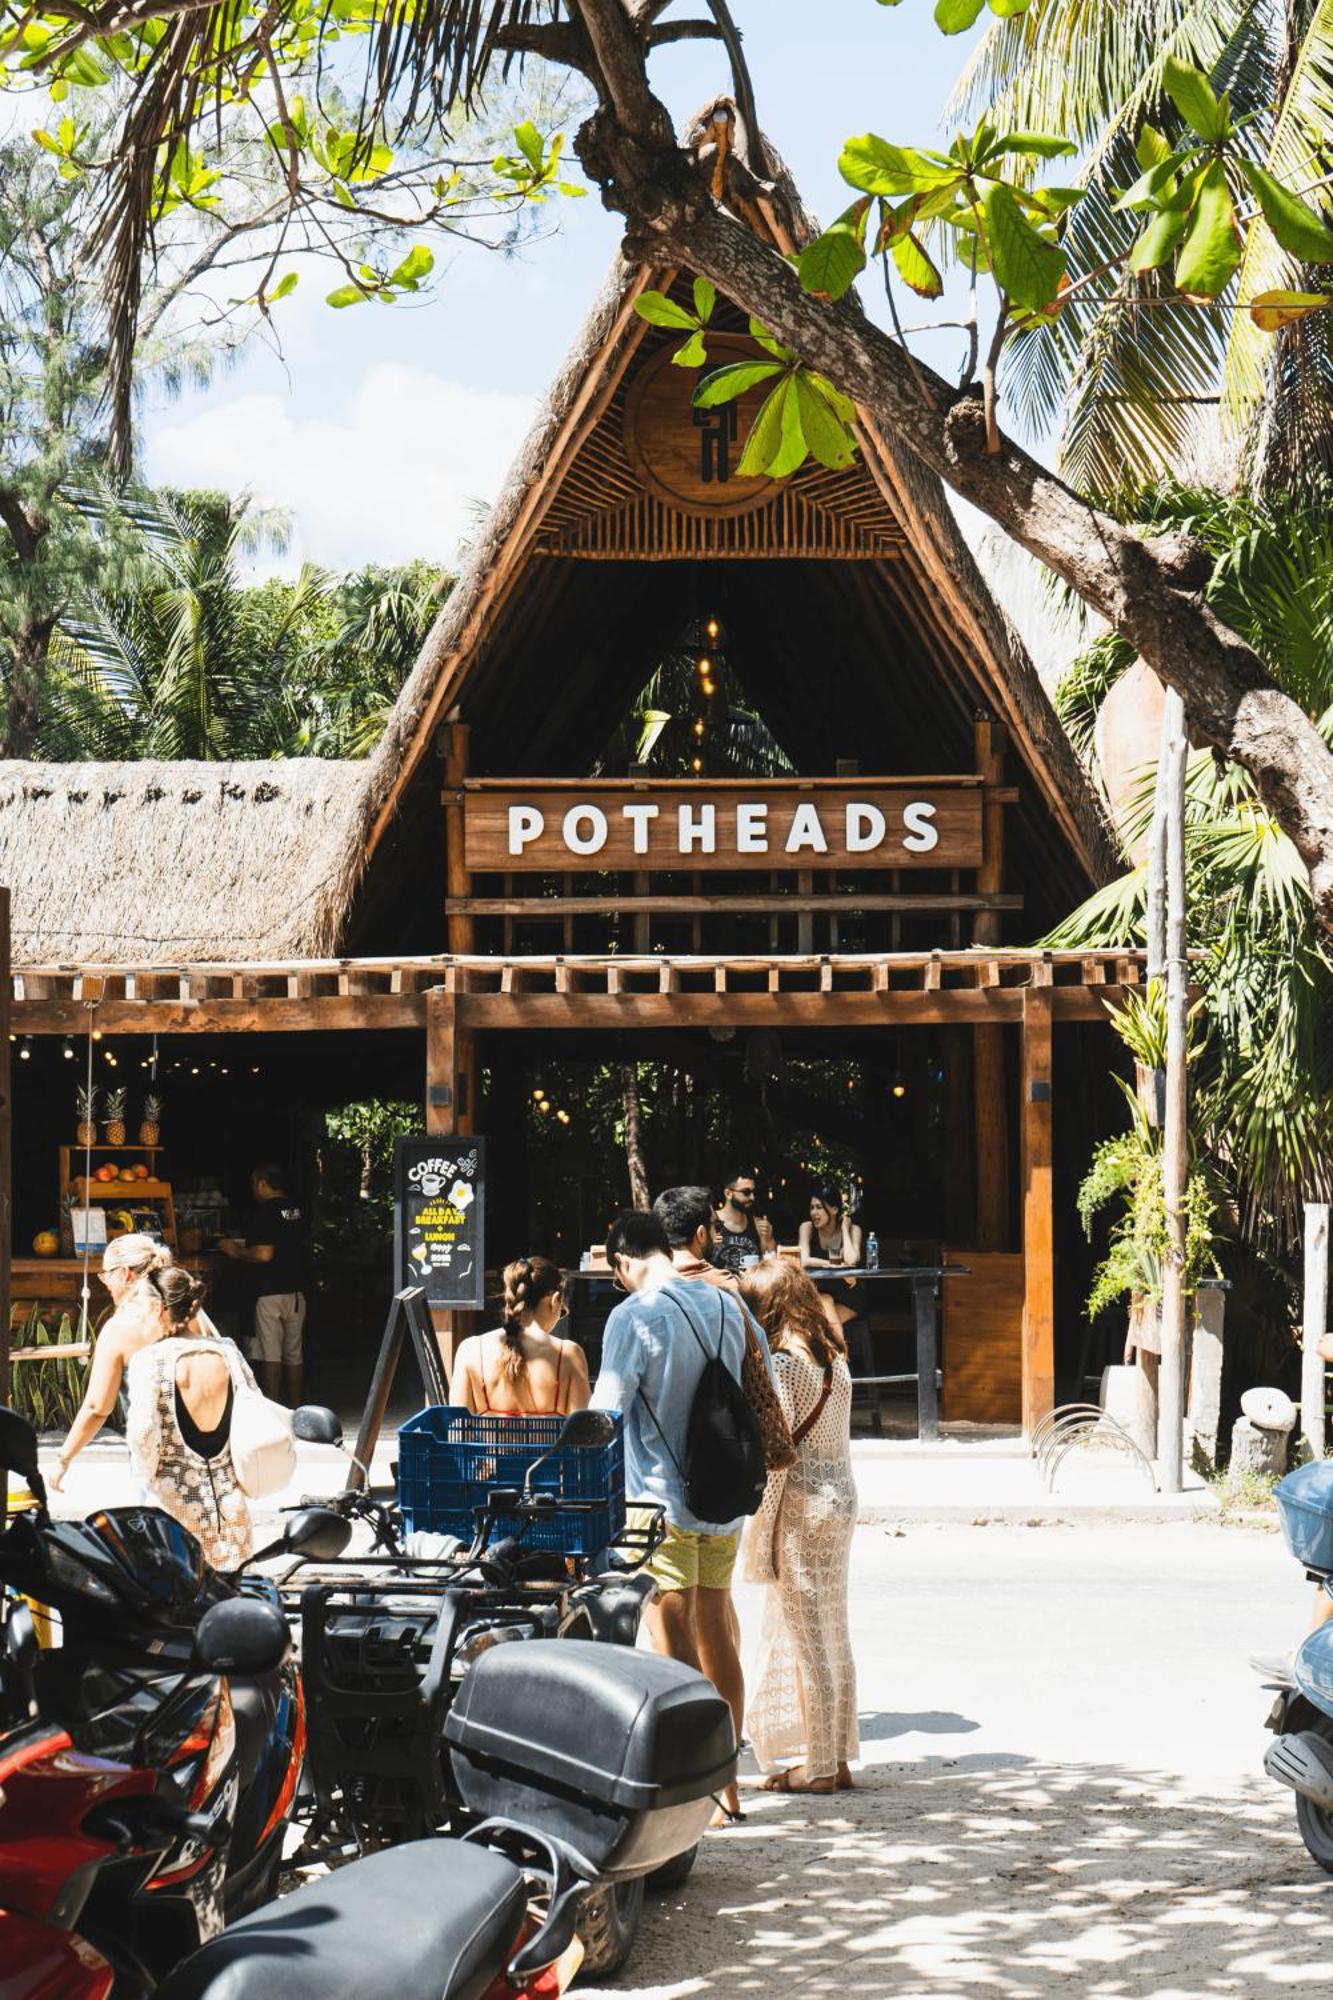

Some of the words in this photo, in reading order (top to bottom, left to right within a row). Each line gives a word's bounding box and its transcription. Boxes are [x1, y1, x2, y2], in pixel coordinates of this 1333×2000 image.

[508, 802, 939, 855] POTHEADS
[408, 1158, 458, 1182] COFFEE
[422, 1207, 437, 1216] ALL
[438, 1207, 457, 1216] DAY
[415, 1216, 466, 1225] BREAKFAST
[424, 1232, 455, 1242] LUNCH
